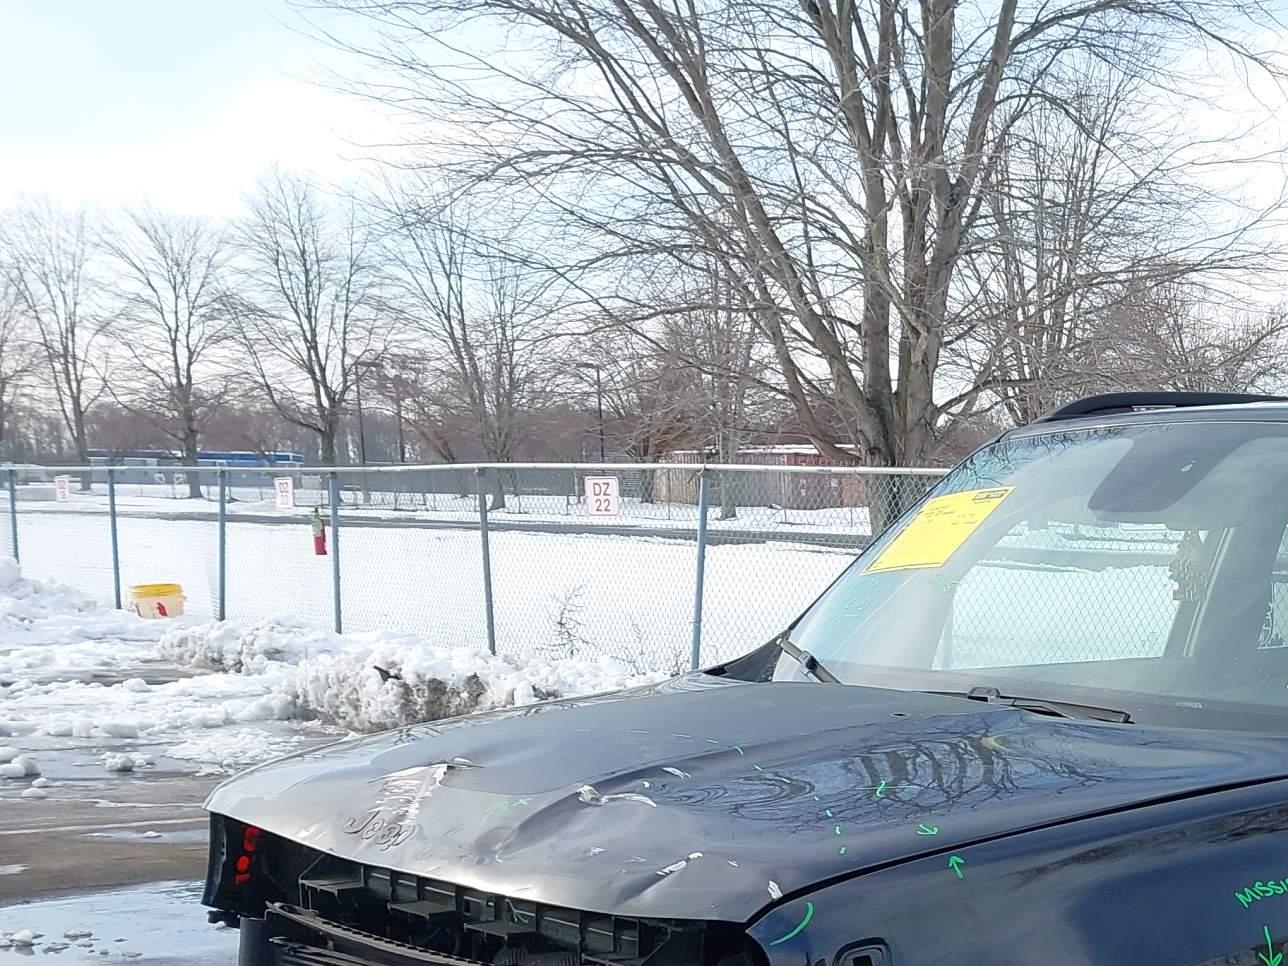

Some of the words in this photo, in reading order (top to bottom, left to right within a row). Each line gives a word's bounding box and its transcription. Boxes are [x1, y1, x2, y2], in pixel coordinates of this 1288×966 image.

[593, 482, 611, 496] DZ
[595, 498, 611, 512] 22
[343, 810, 416, 852] Jeep
